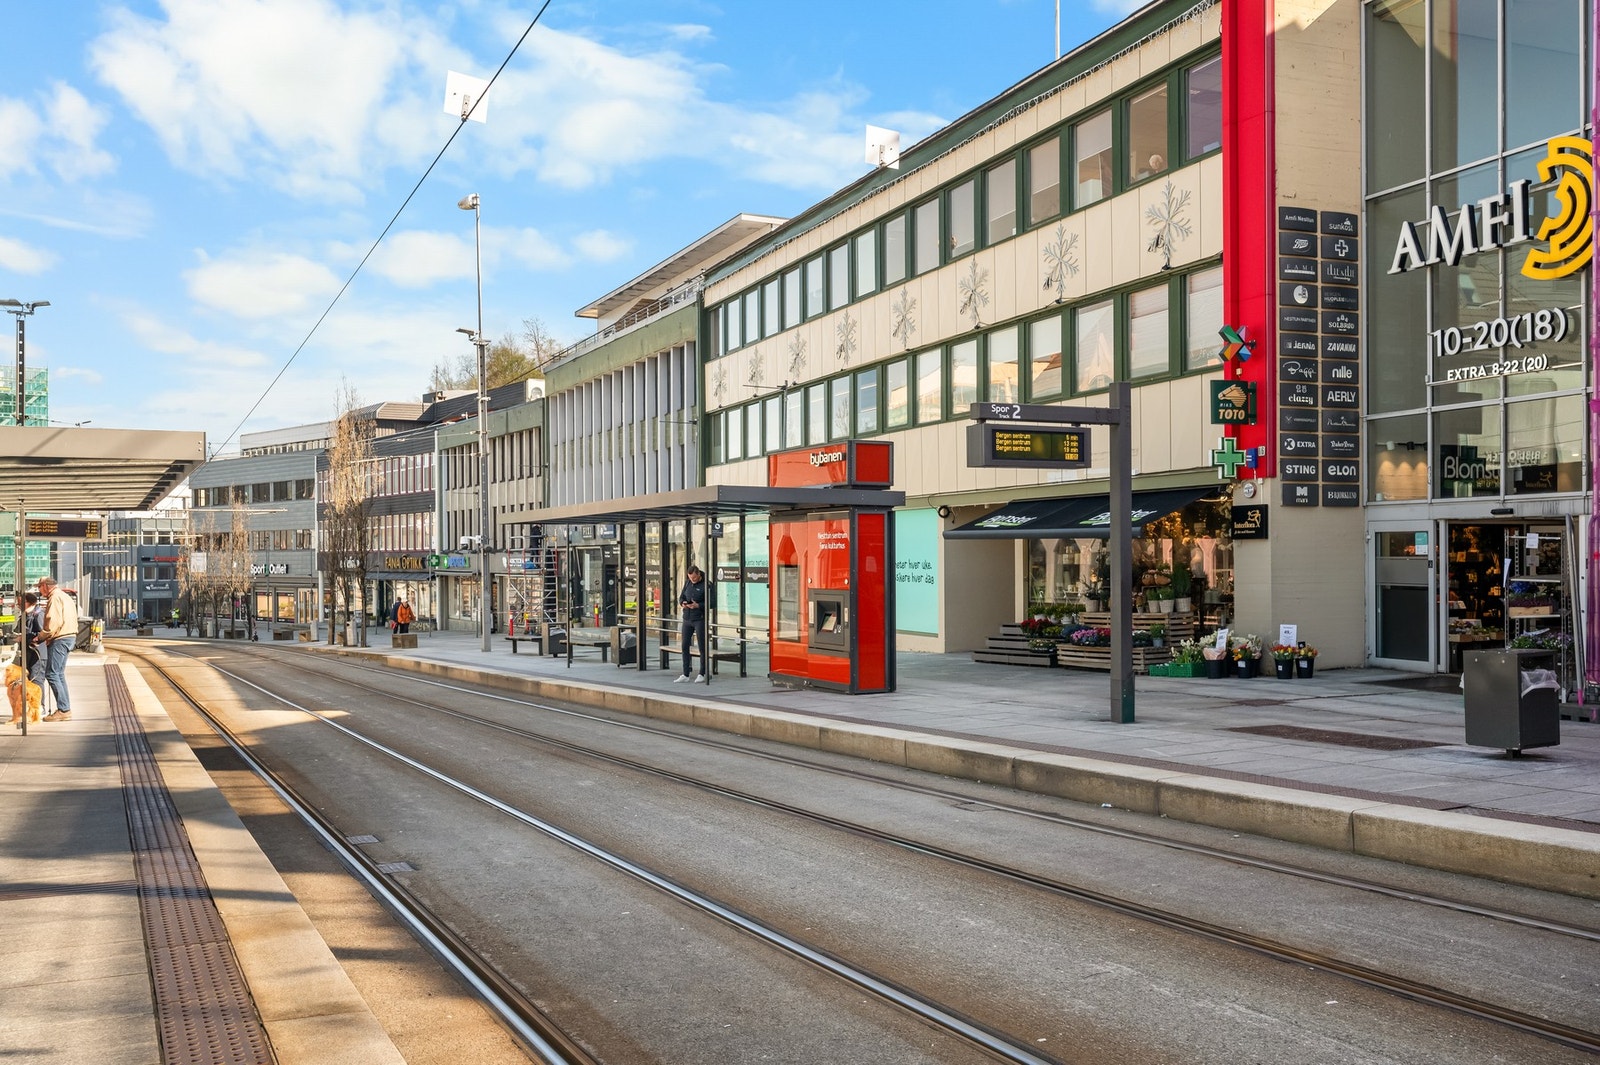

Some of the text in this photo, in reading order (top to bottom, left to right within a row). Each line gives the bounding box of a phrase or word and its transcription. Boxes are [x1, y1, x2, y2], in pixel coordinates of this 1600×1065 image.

[1329, 223, 1353, 232] sunkost
[1387, 179, 1532, 275] AMFI
[1433, 307, 1568, 357] 10-20(18)
[1332, 365, 1353, 379] nille
[1447, 353, 1549, 381] EXTRA 8-22 (20)
[1327, 391, 1356, 402] AERLY
[991, 404, 1021, 419] Spor 2
[1218, 408, 1246, 420] TOTO
[810, 451, 842, 467] bybanen
[1285, 464, 1316, 475] STING
[384, 556, 400, 568] FANA
[250, 564, 265, 575] Sport
[269, 563, 287, 574] Outlet
